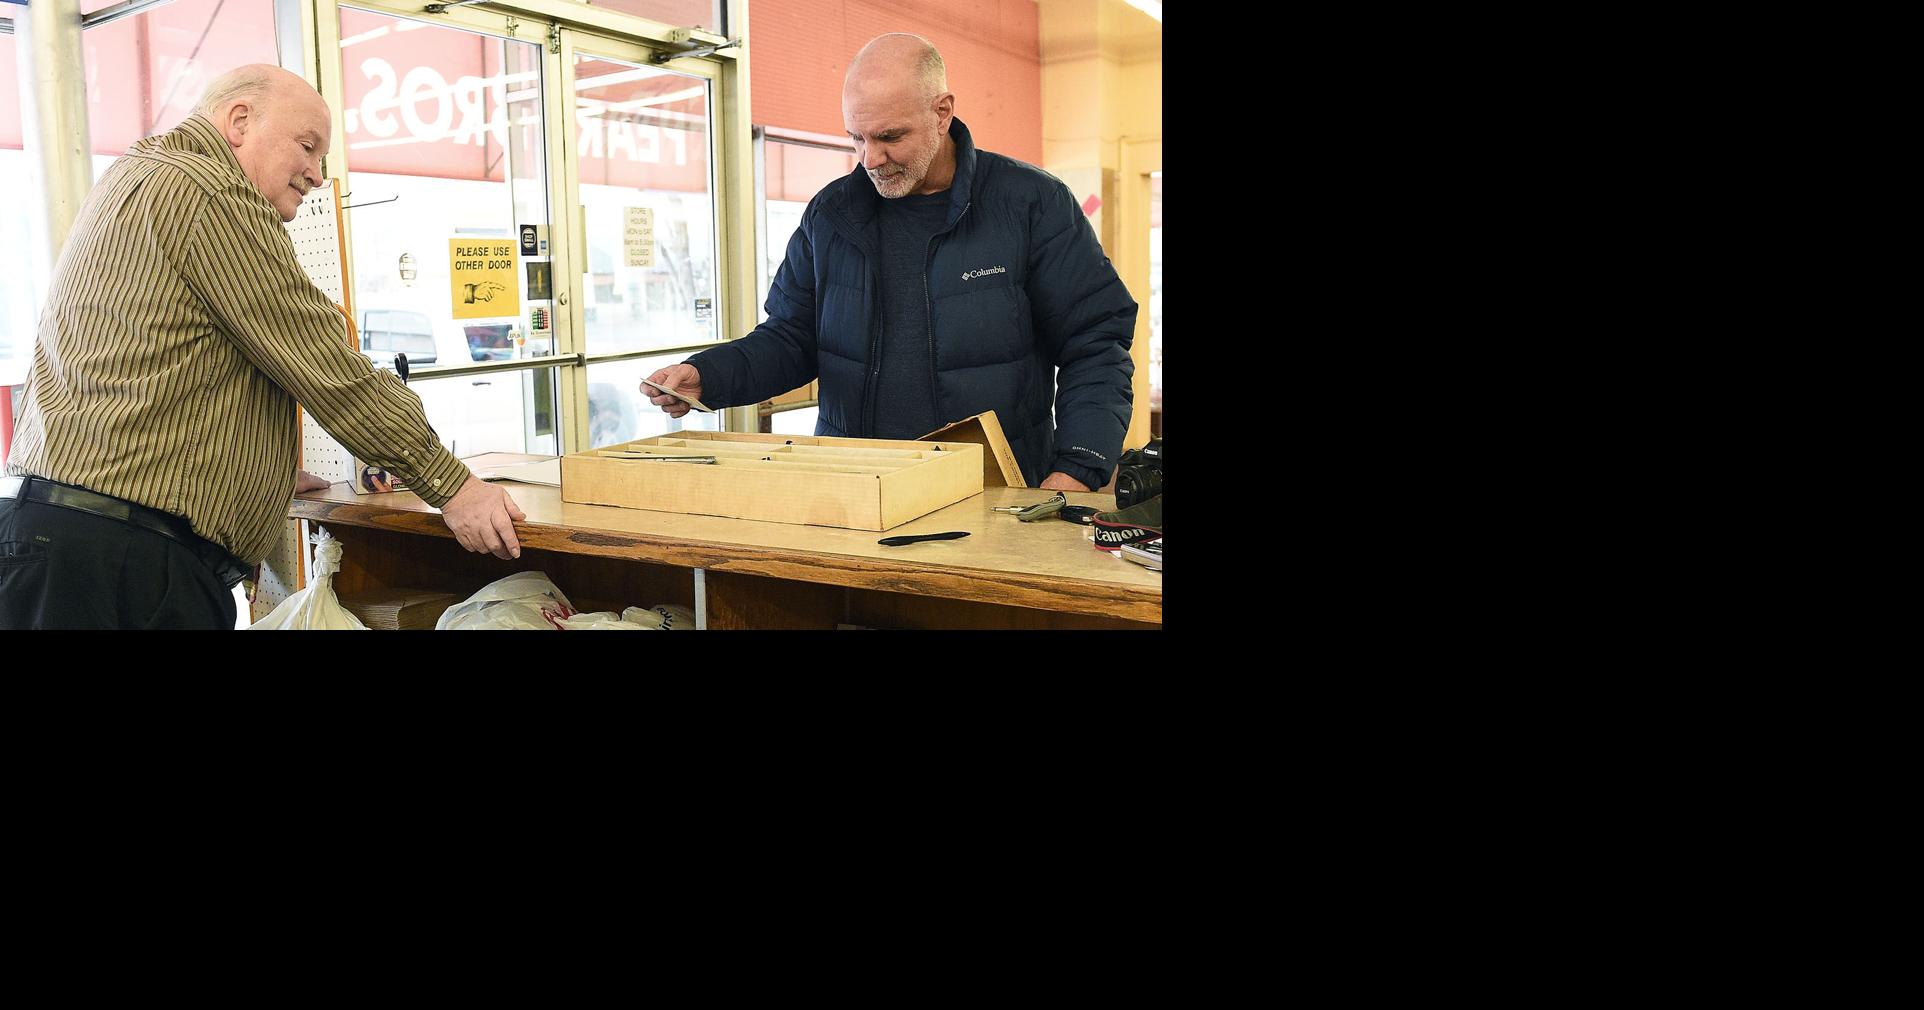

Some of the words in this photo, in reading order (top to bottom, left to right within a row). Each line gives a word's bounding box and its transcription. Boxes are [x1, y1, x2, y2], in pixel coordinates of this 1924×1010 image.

[455, 246, 489, 257] PLEASE
[493, 246, 510, 256] USE
[455, 260, 484, 271] OTHER
[488, 259, 512, 270] DOOR
[970, 265, 1006, 279] Columbia
[1144, 448, 1158, 456] Canon
[1095, 527, 1145, 542] Canon
